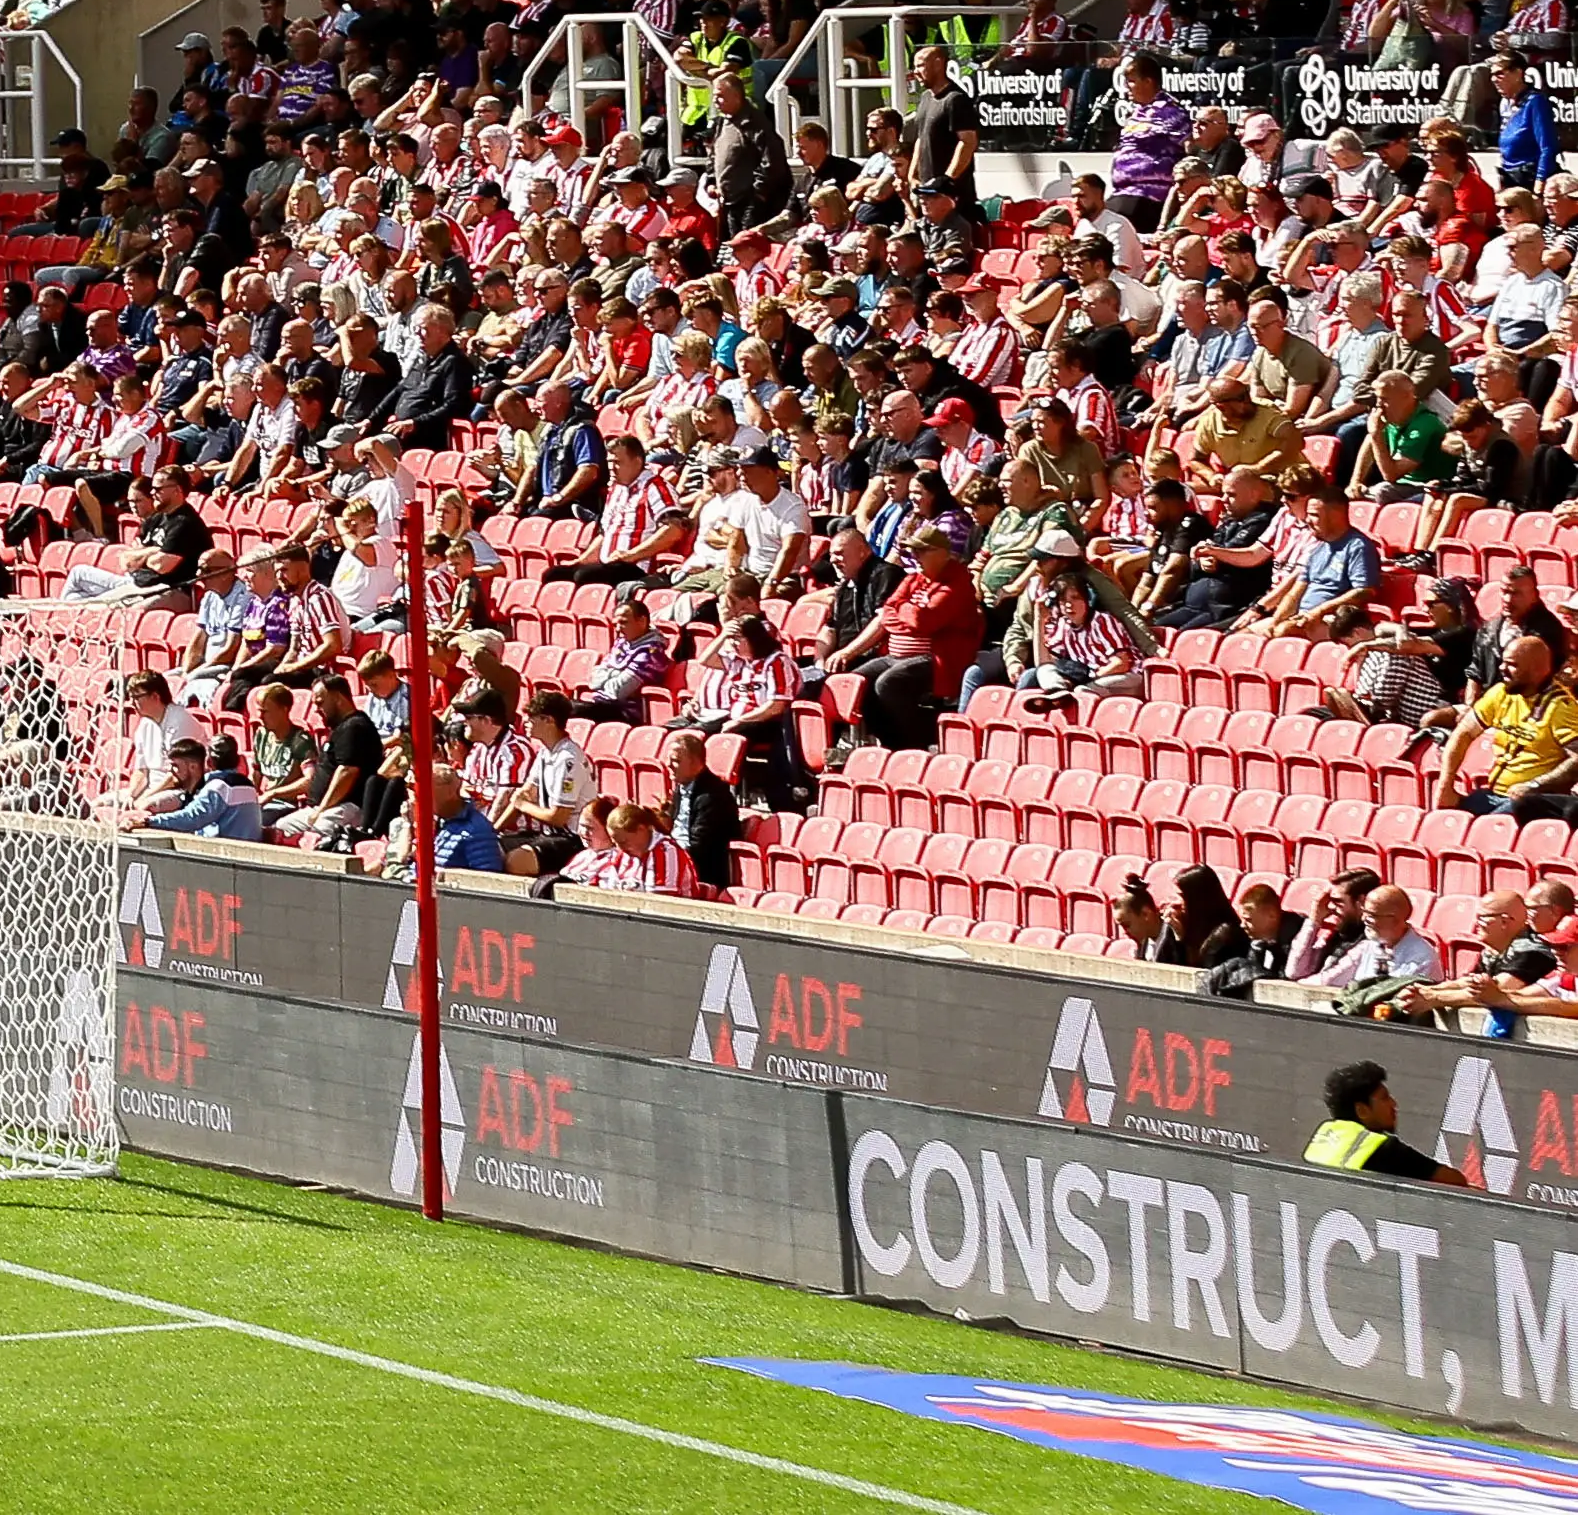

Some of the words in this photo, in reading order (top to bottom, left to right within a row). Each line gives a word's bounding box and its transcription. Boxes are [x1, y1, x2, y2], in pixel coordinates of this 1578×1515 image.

[977, 68, 1043, 98] University
[1044, 67, 1062, 94] of
[979, 100, 1067, 127] Staffordshire
[1228, 65, 1245, 93] of
[1344, 64, 1423, 96] University
[1423, 63, 1440, 91] of
[170, 885, 244, 961] ADF
[451, 925, 536, 1003] ADF
[121, 1000, 208, 1088] ADF
[767, 973, 863, 1057] ADF
[120, 1086, 232, 1133] CONSTRUCTION
[766, 1054, 888, 1092] CONSTRUCTION
[1125, 1027, 1233, 1117] ADF
[476, 1063, 574, 1158] ADF
[1528, 1089, 1578, 1177] A
[475, 1155, 604, 1208] CONSTRUCTION
[847, 1127, 1467, 1418] CONSTRUCT,
